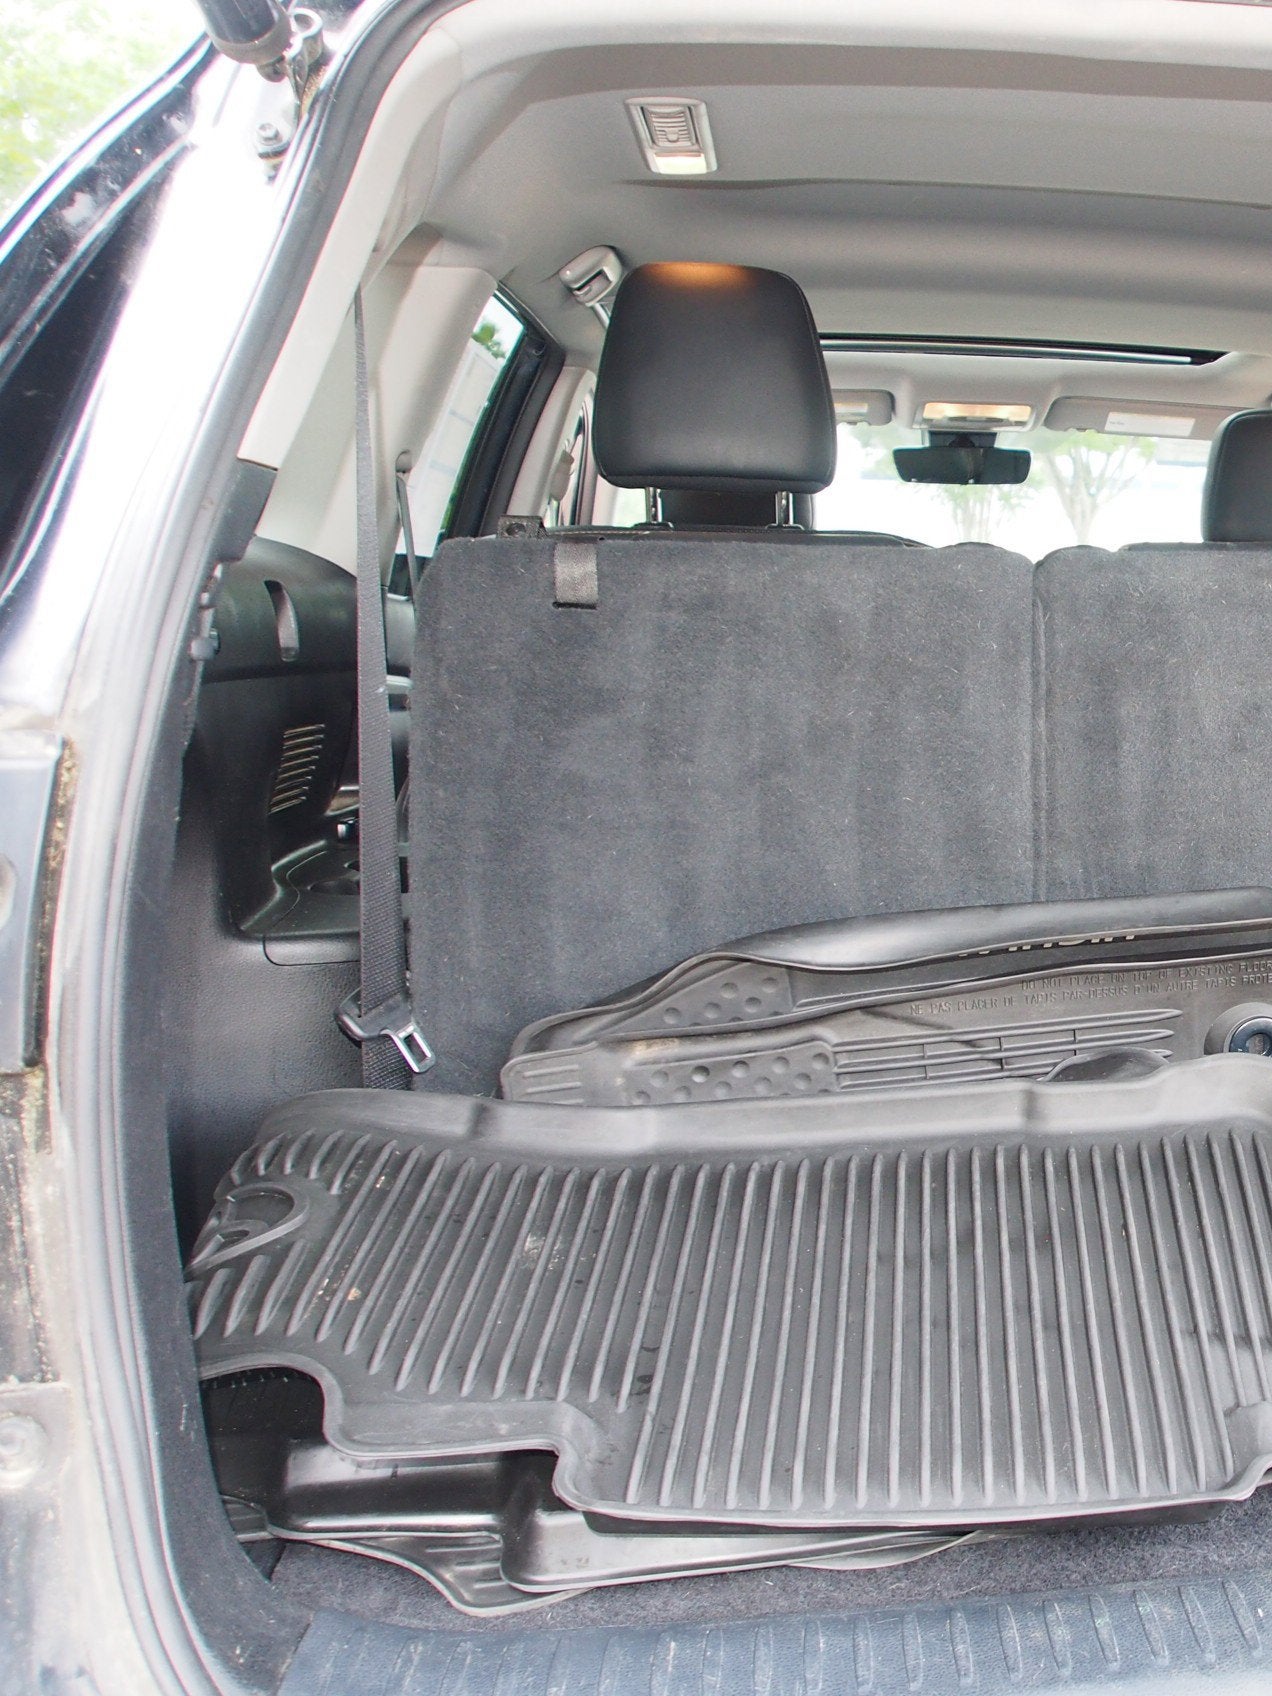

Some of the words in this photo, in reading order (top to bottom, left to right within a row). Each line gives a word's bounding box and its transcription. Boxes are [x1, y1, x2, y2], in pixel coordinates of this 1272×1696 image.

[1021, 980, 1036, 991] DO
[1042, 977, 1062, 989] NOT
[1070, 973, 1105, 986] PLACE
[1111, 971, 1125, 983] ON
[1179, 963, 1233, 978] EXISTING
[1240, 960, 1272, 973] FLOOR
[910, 1004, 924, 1015] NE
[930, 1002, 952, 1013] PAS
[957, 998, 998, 1011] PLACER
[1166, 980, 1198, 992] AUTRE
